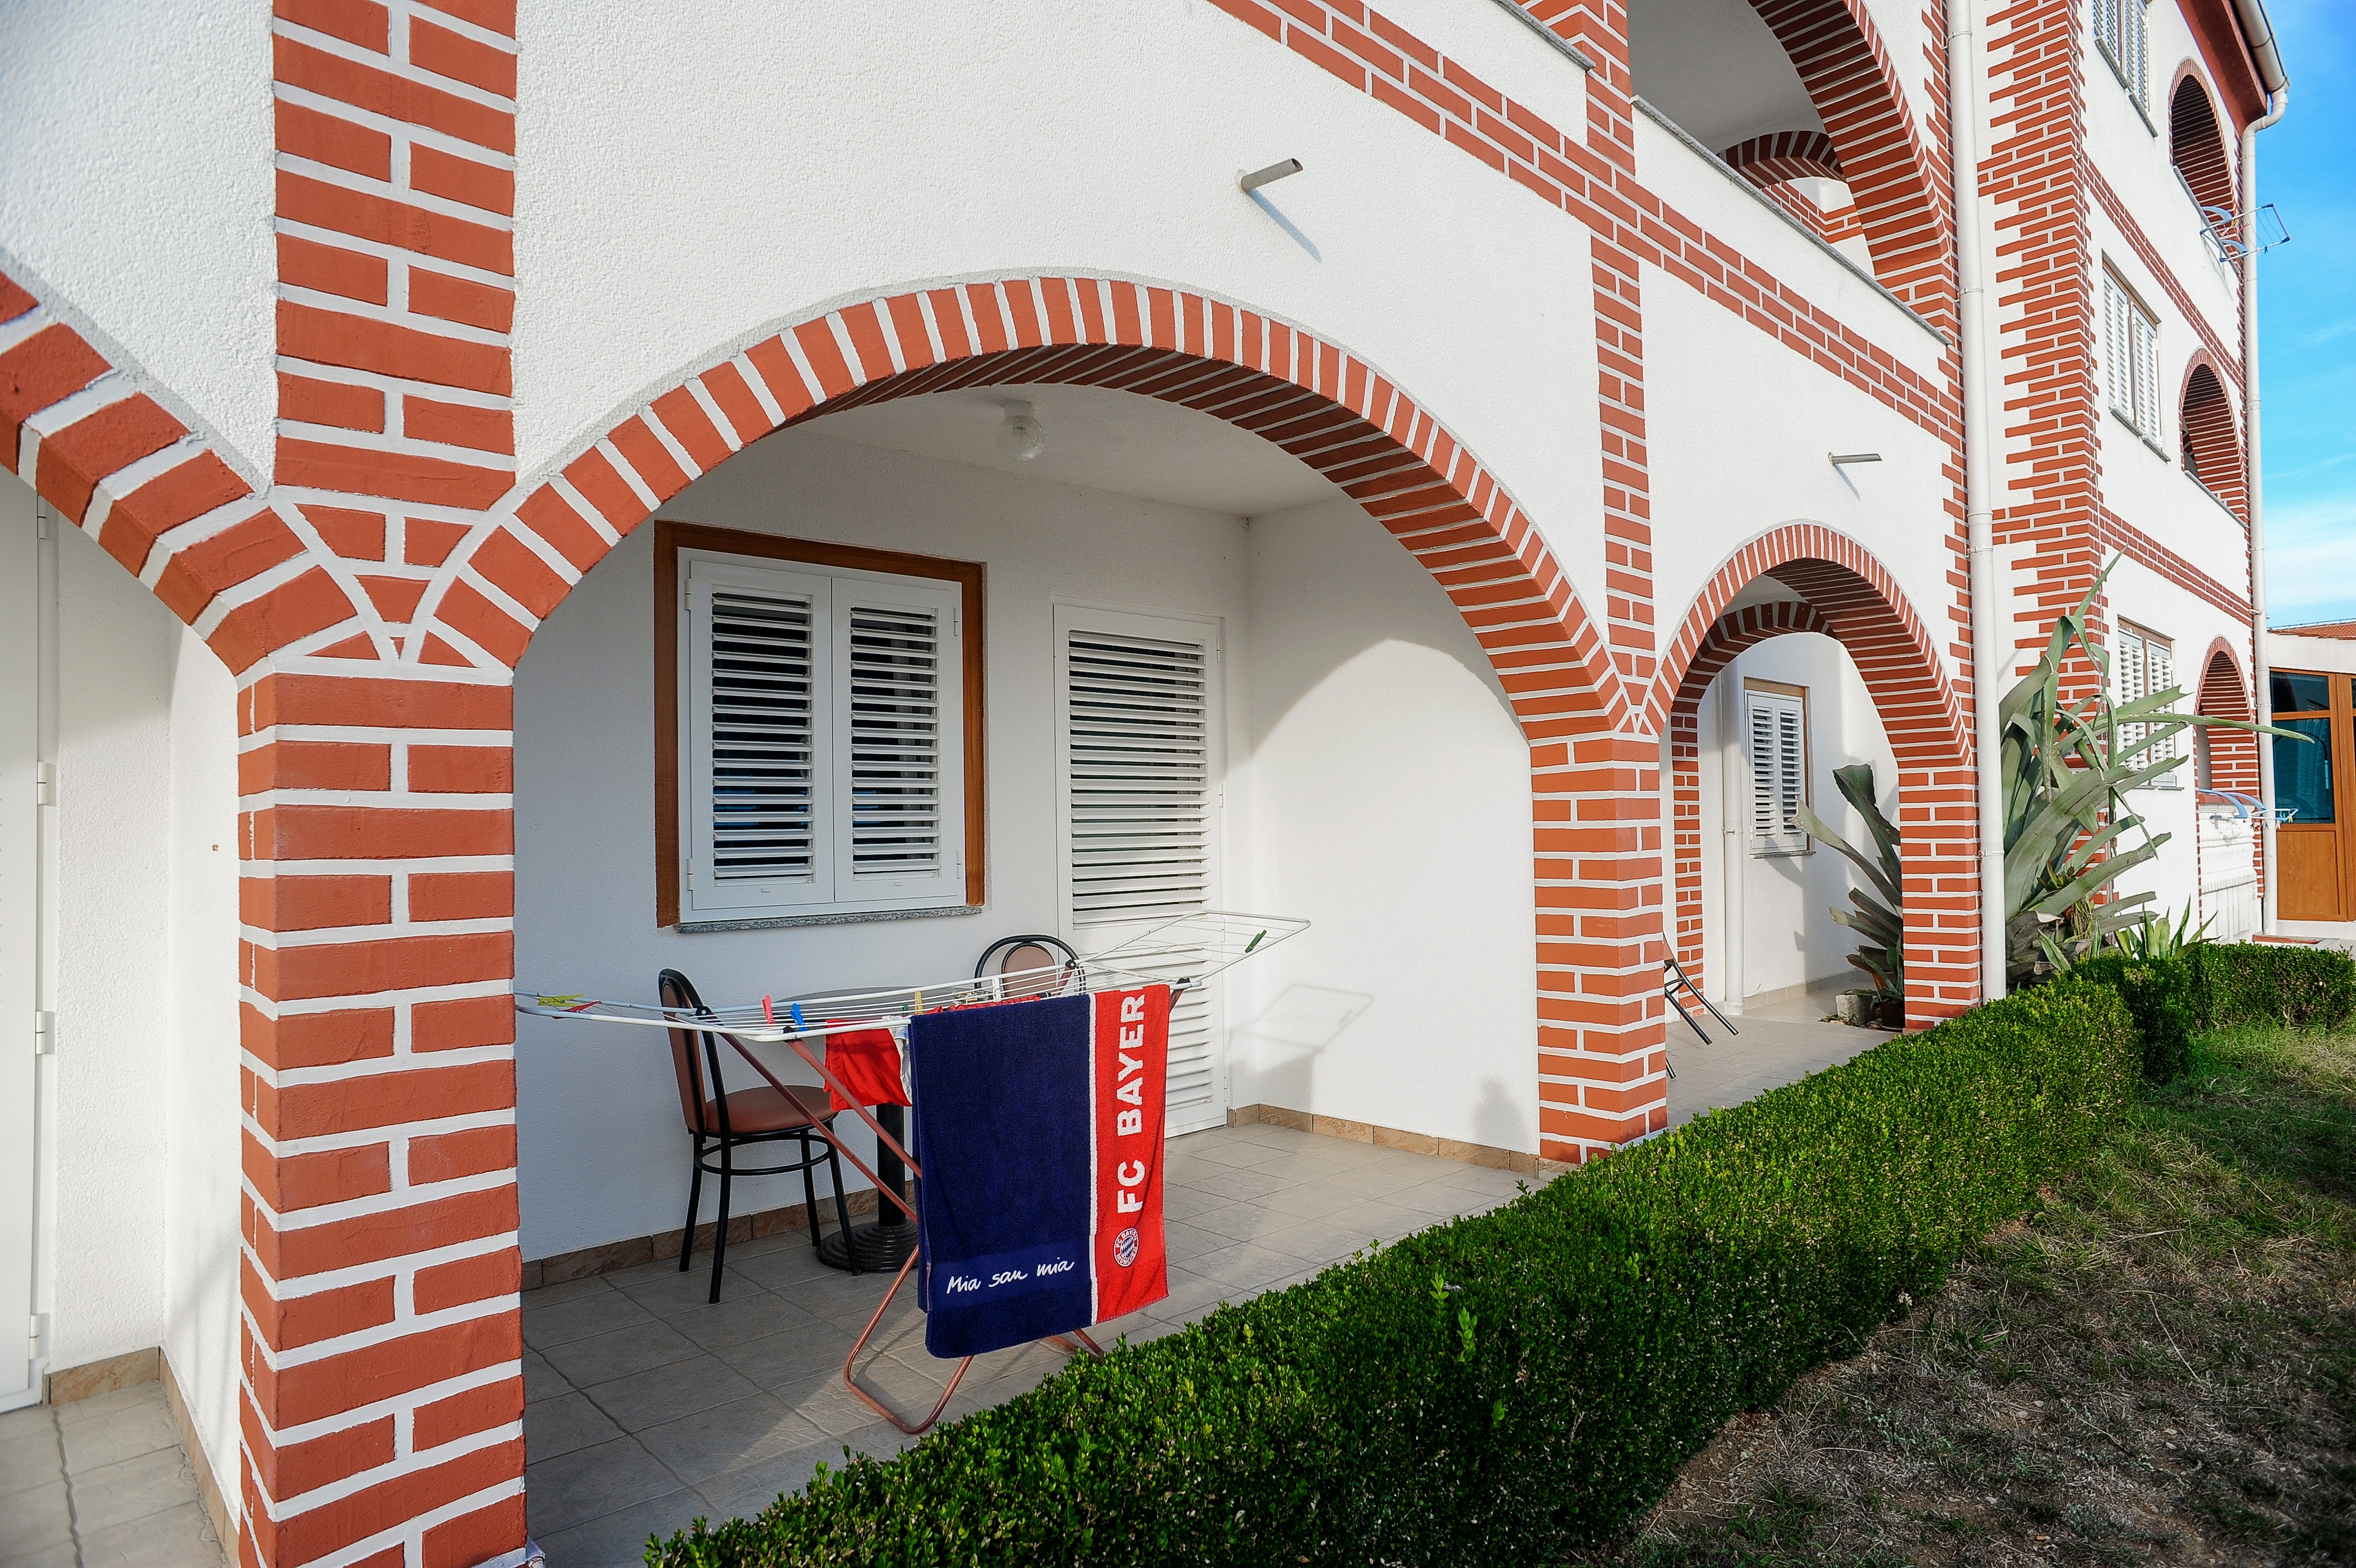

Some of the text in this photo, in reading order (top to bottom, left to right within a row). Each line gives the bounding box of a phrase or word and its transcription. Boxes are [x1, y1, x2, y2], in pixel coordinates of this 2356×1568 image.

[1116, 987, 1146, 1214] FC BAYER
[1116, 1238, 1123, 1248] FC
[946, 1275, 982, 1294] Mia
[1036, 1256, 1075, 1277] mia
